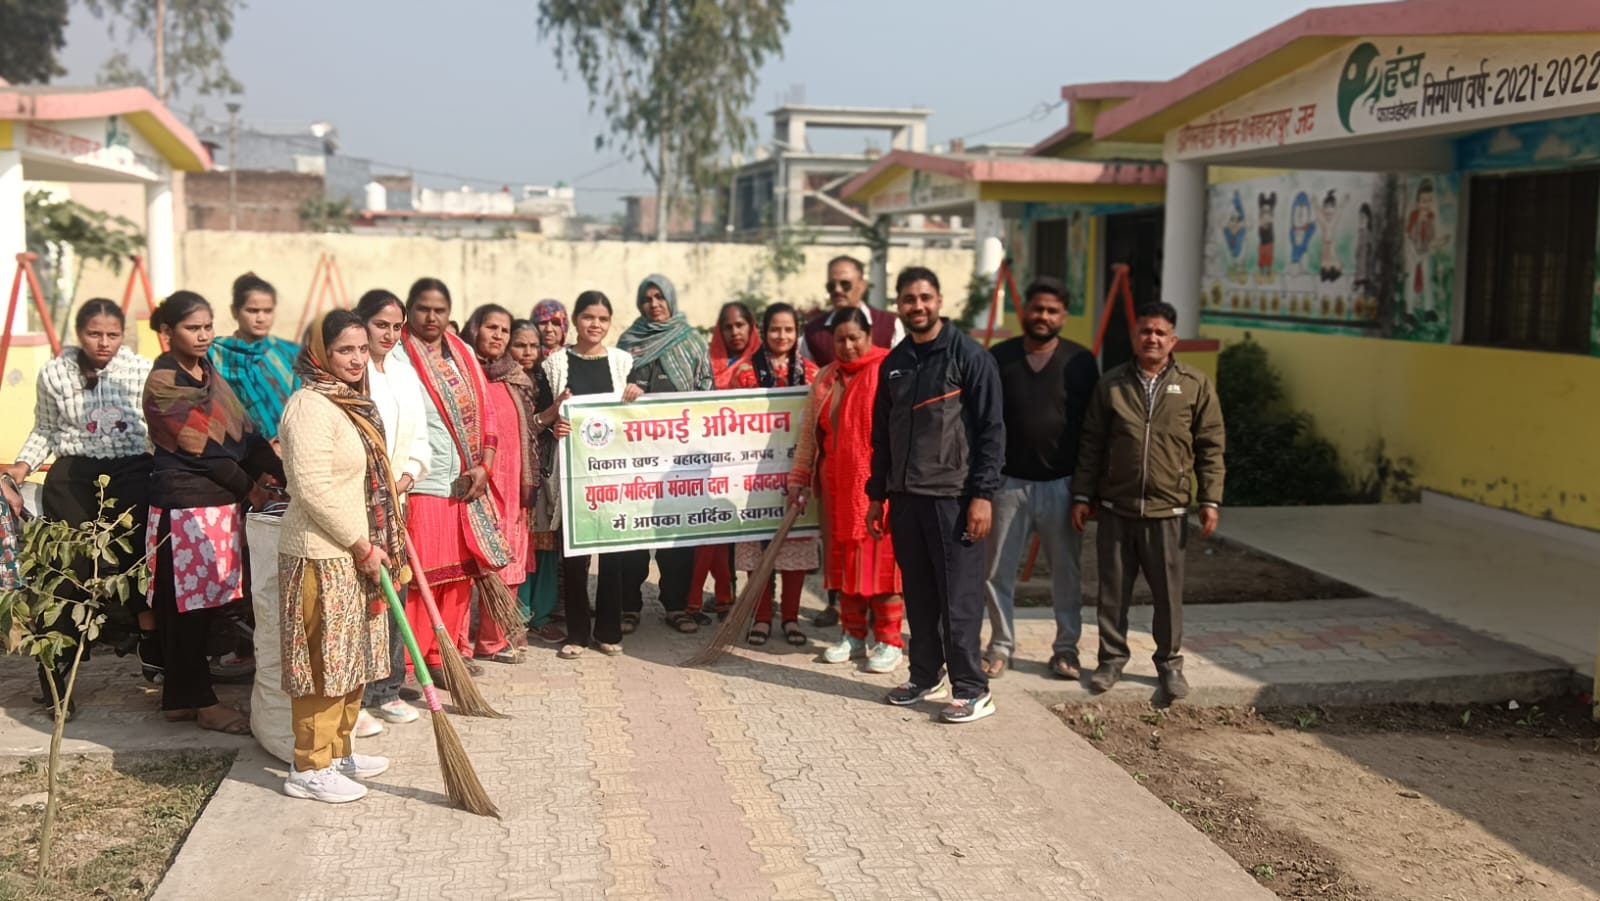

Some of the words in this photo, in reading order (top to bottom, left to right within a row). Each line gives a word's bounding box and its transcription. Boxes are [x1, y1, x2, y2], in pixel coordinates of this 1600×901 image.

[1384, 45, 1425, 97] हंस
[1421, 66, 1466, 117] निर्माण
[622, 409, 690, 443] सफाई
[702, 407, 791, 437] अभियान
[588, 456, 627, 471] विकास
[632, 456, 659, 468] खण्ड
[740, 449, 775, 461] जनपद
[667, 474, 704, 498] मंगल
[706, 477, 729, 495] दल
[613, 513, 626, 529] में
[633, 513, 681, 528] आपका
[687, 507, 732, 524] हार्दिक
[739, 506, 784, 520] स्वागत
